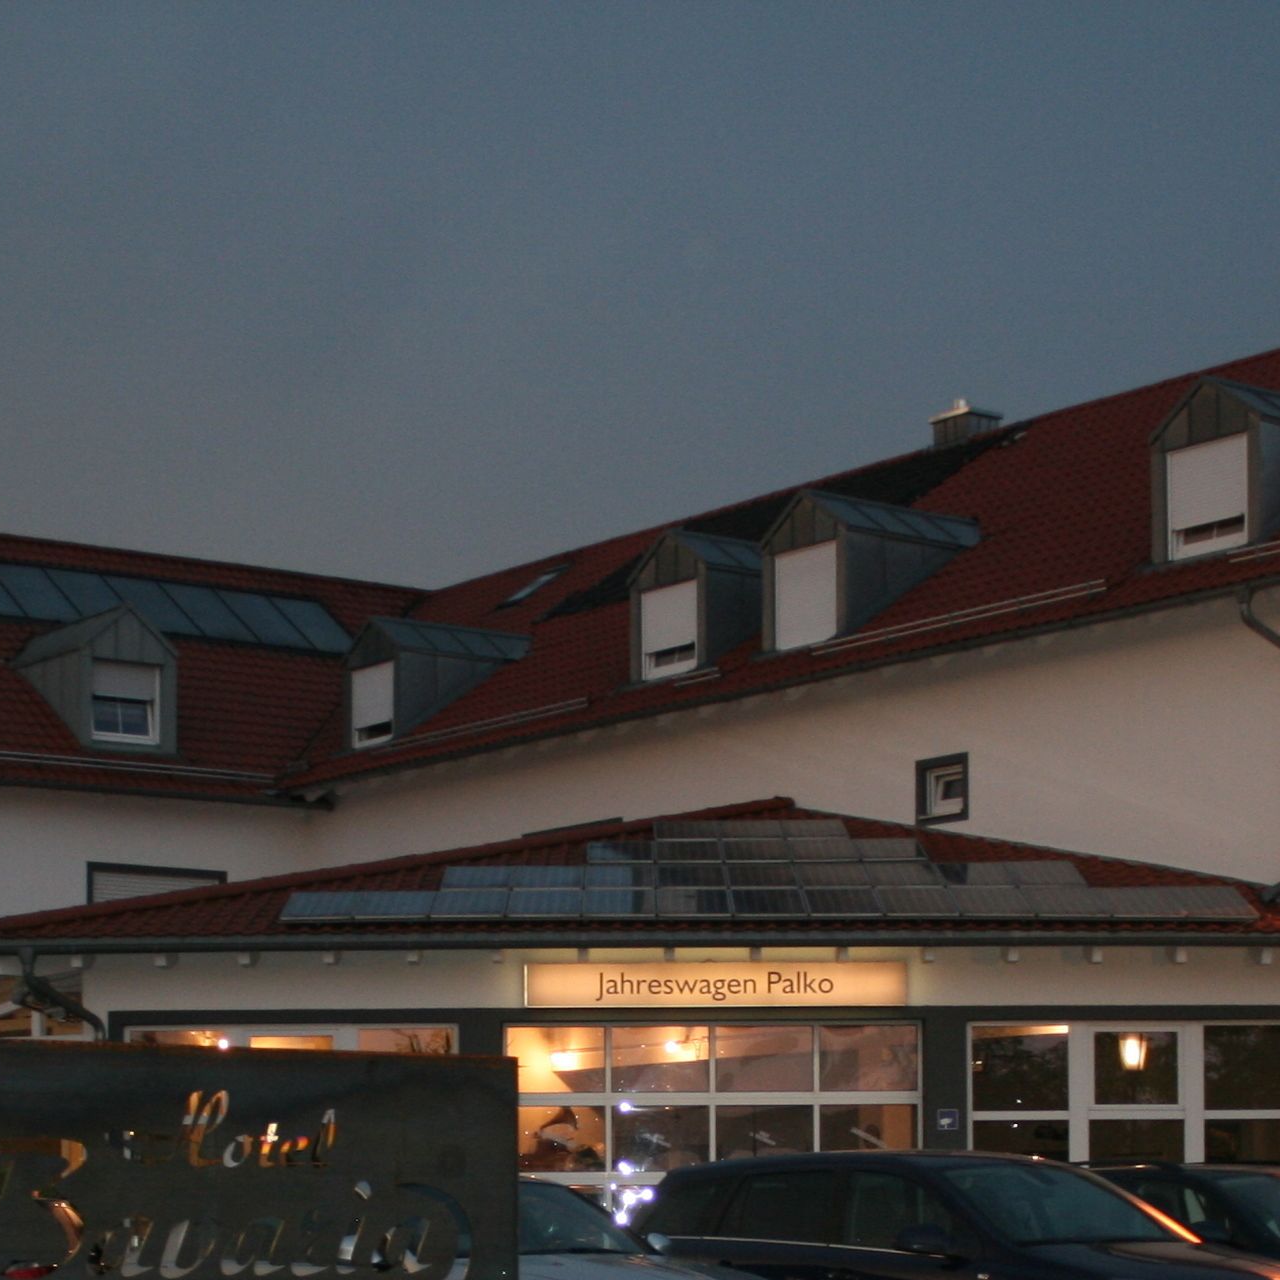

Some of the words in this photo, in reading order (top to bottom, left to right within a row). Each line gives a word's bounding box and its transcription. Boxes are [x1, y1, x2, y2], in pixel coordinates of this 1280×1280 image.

[596, 971, 757, 1001] Jahreswagen
[766, 970, 835, 995] Palko
[108, 1089, 336, 1169] Hotel
